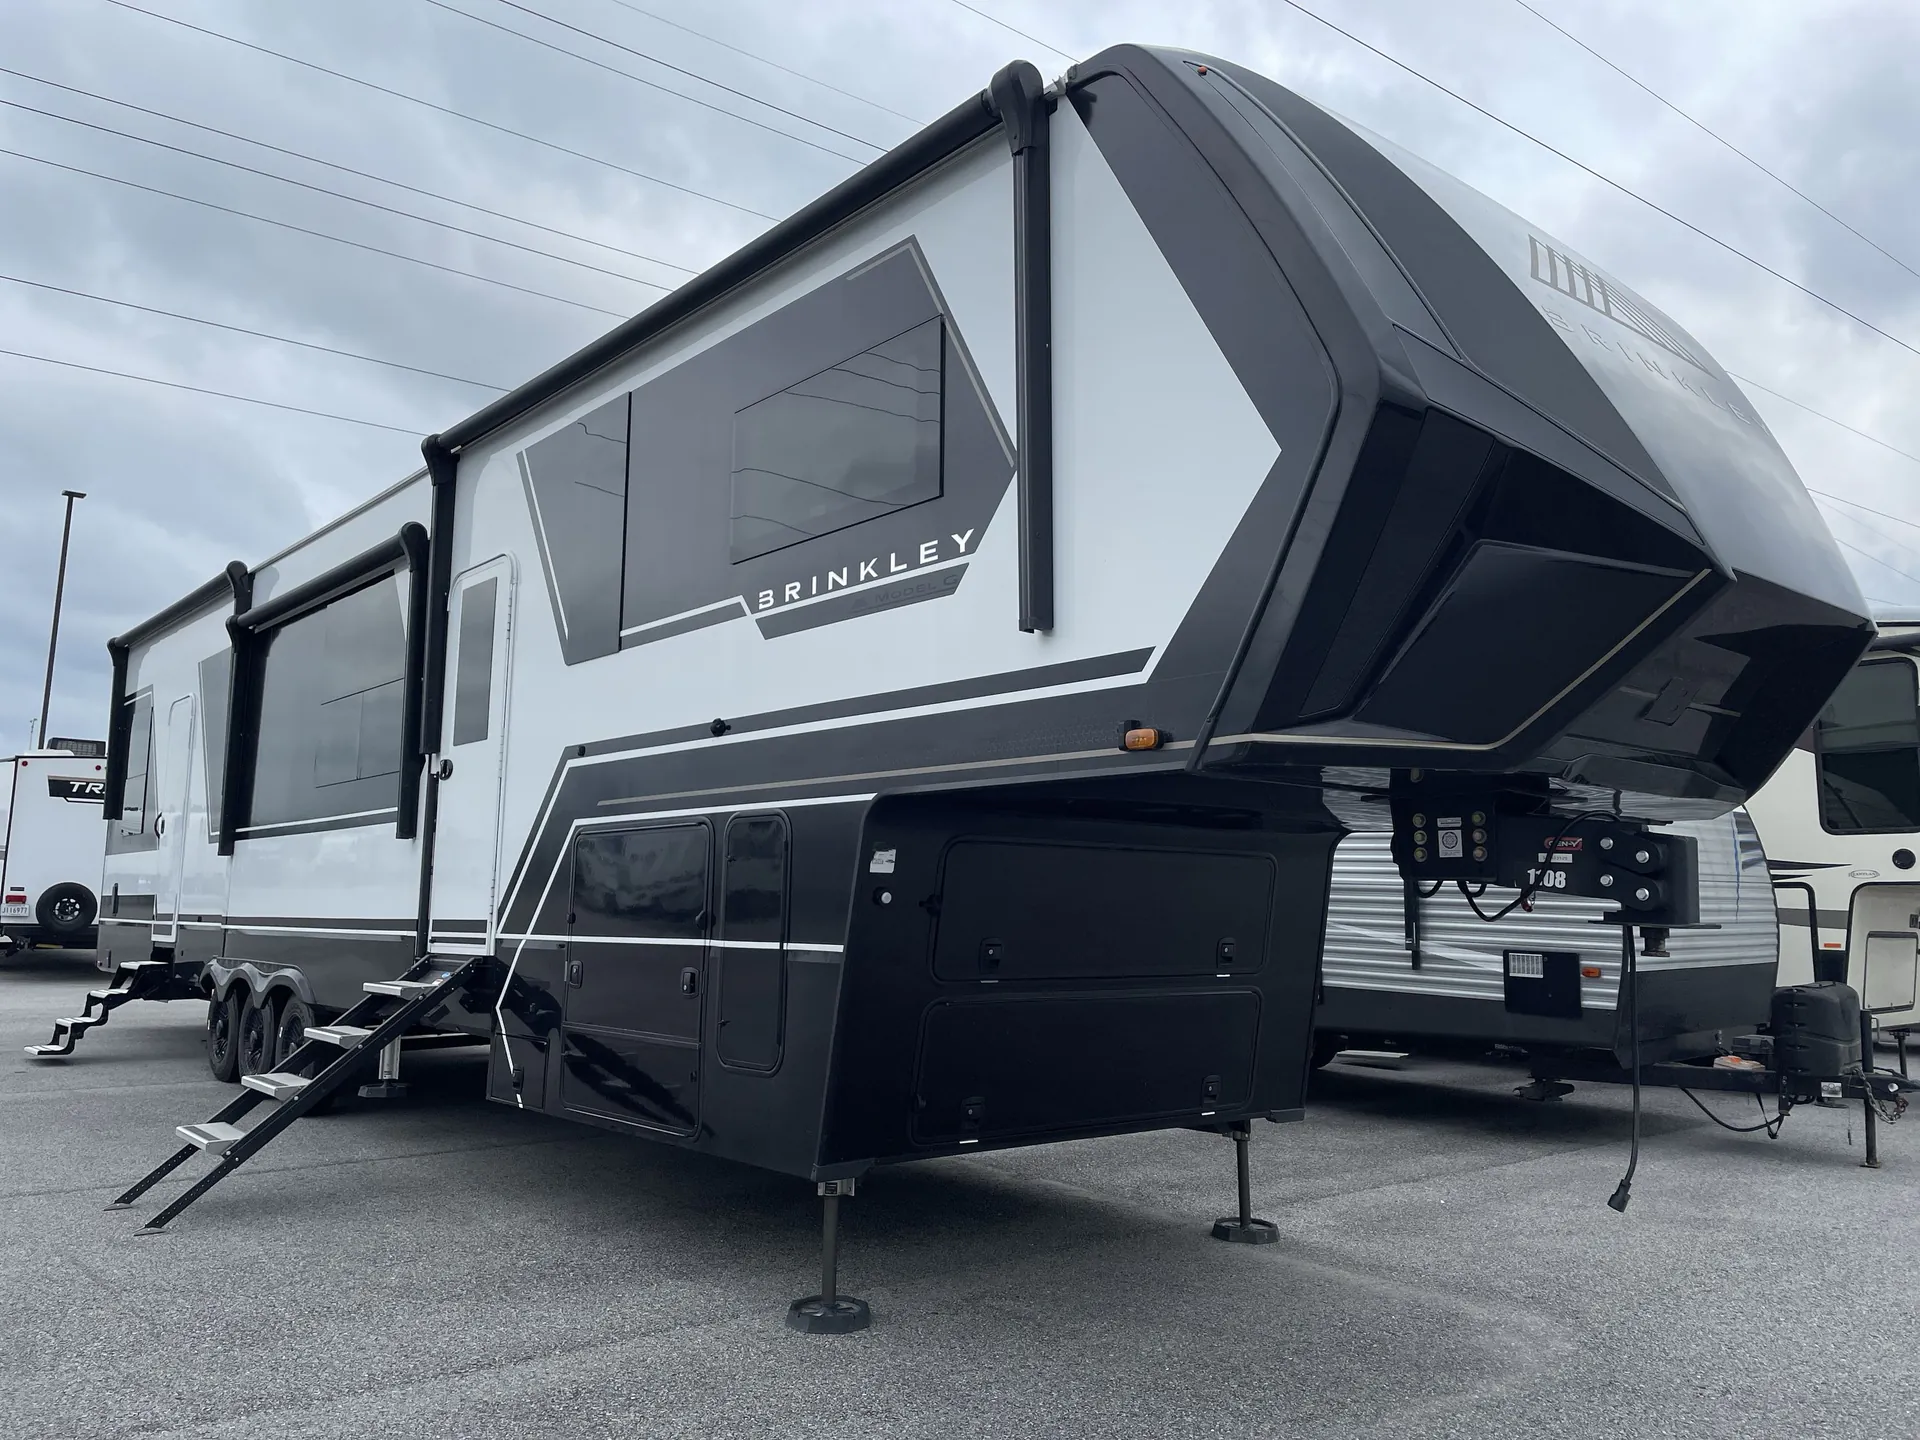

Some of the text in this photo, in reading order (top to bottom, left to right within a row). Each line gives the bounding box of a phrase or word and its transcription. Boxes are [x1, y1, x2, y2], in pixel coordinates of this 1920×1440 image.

[758, 528, 975, 610] BRINKLEY
[69, 781, 105, 794] TR
[1527, 868, 1566, 888] 108
